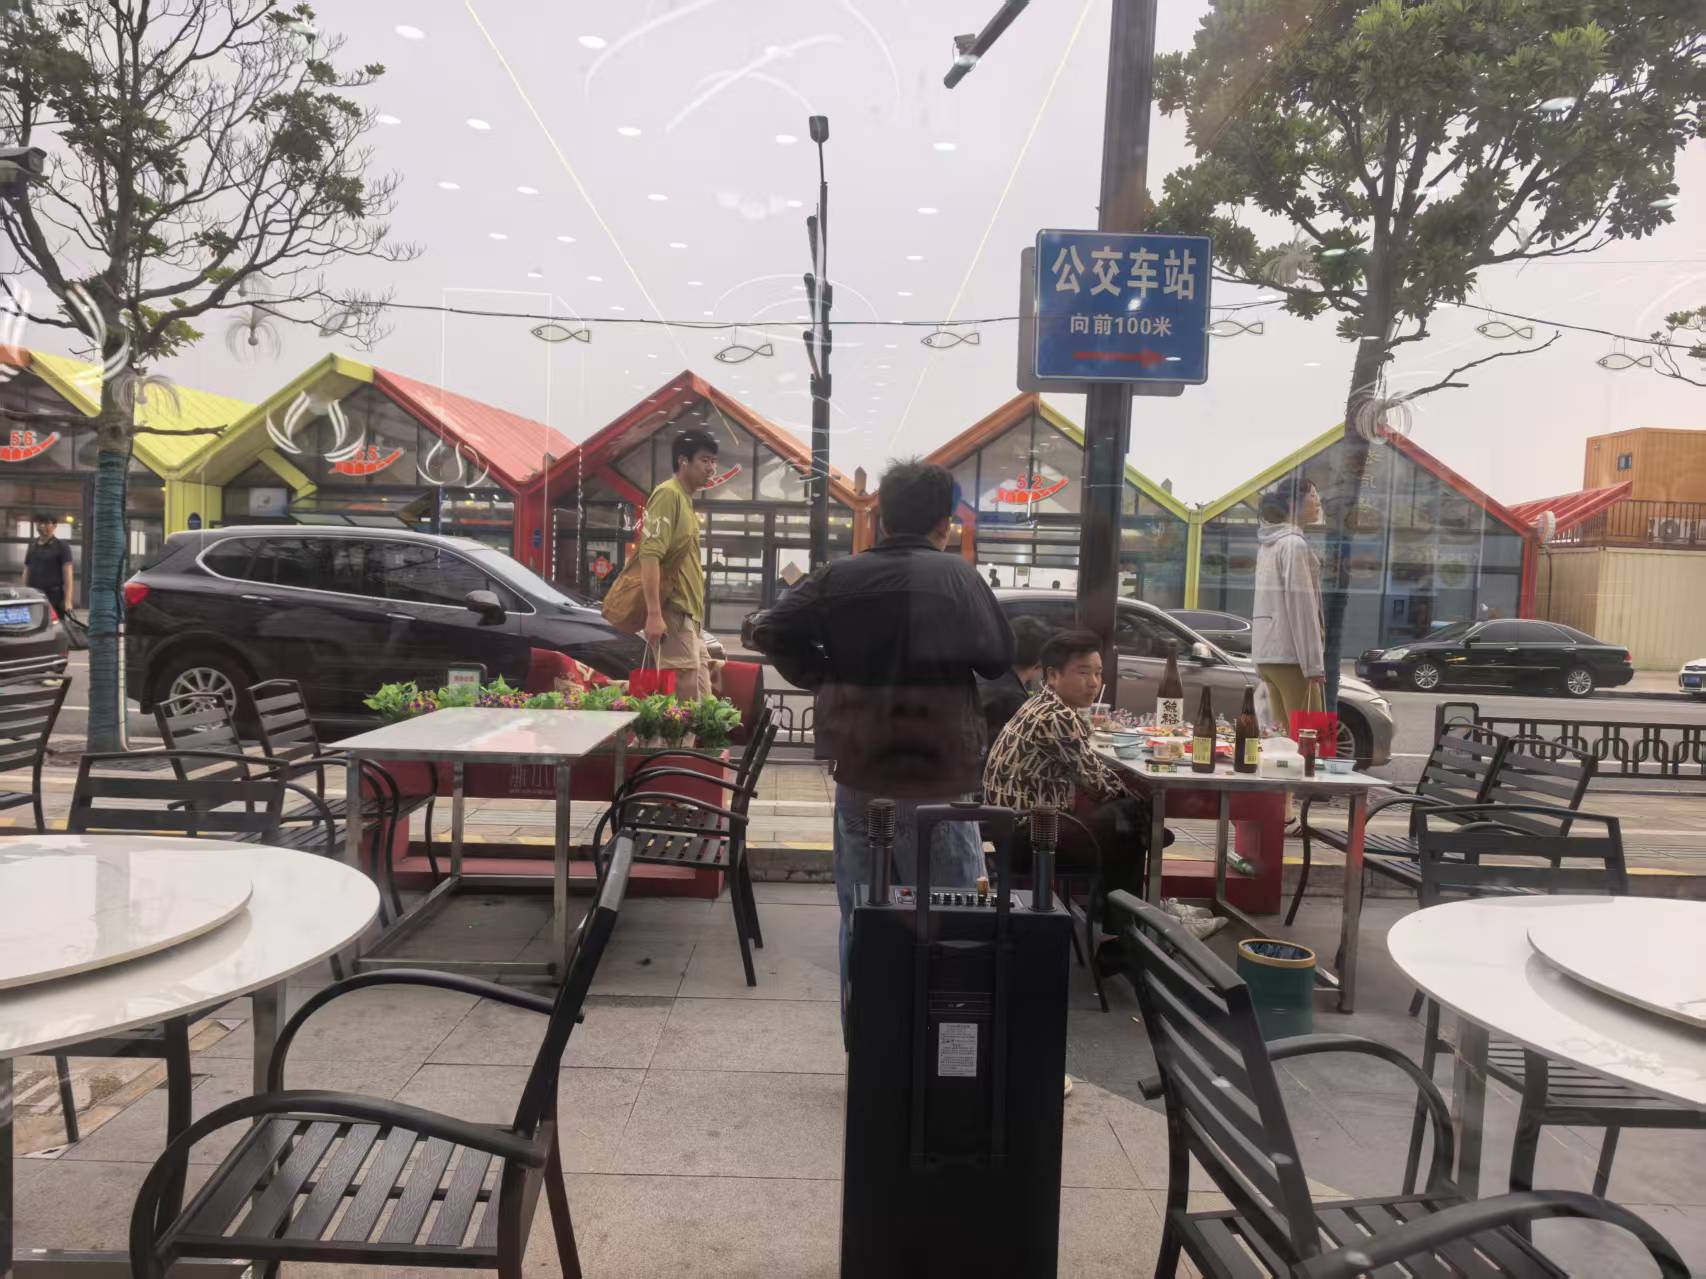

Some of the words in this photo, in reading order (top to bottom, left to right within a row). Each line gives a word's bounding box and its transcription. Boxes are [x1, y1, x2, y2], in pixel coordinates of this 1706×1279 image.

[1050, 244, 1198, 301] 公交车站
[1069, 312, 1174, 337] 向前100米
[10, 431, 36, 447] 56
